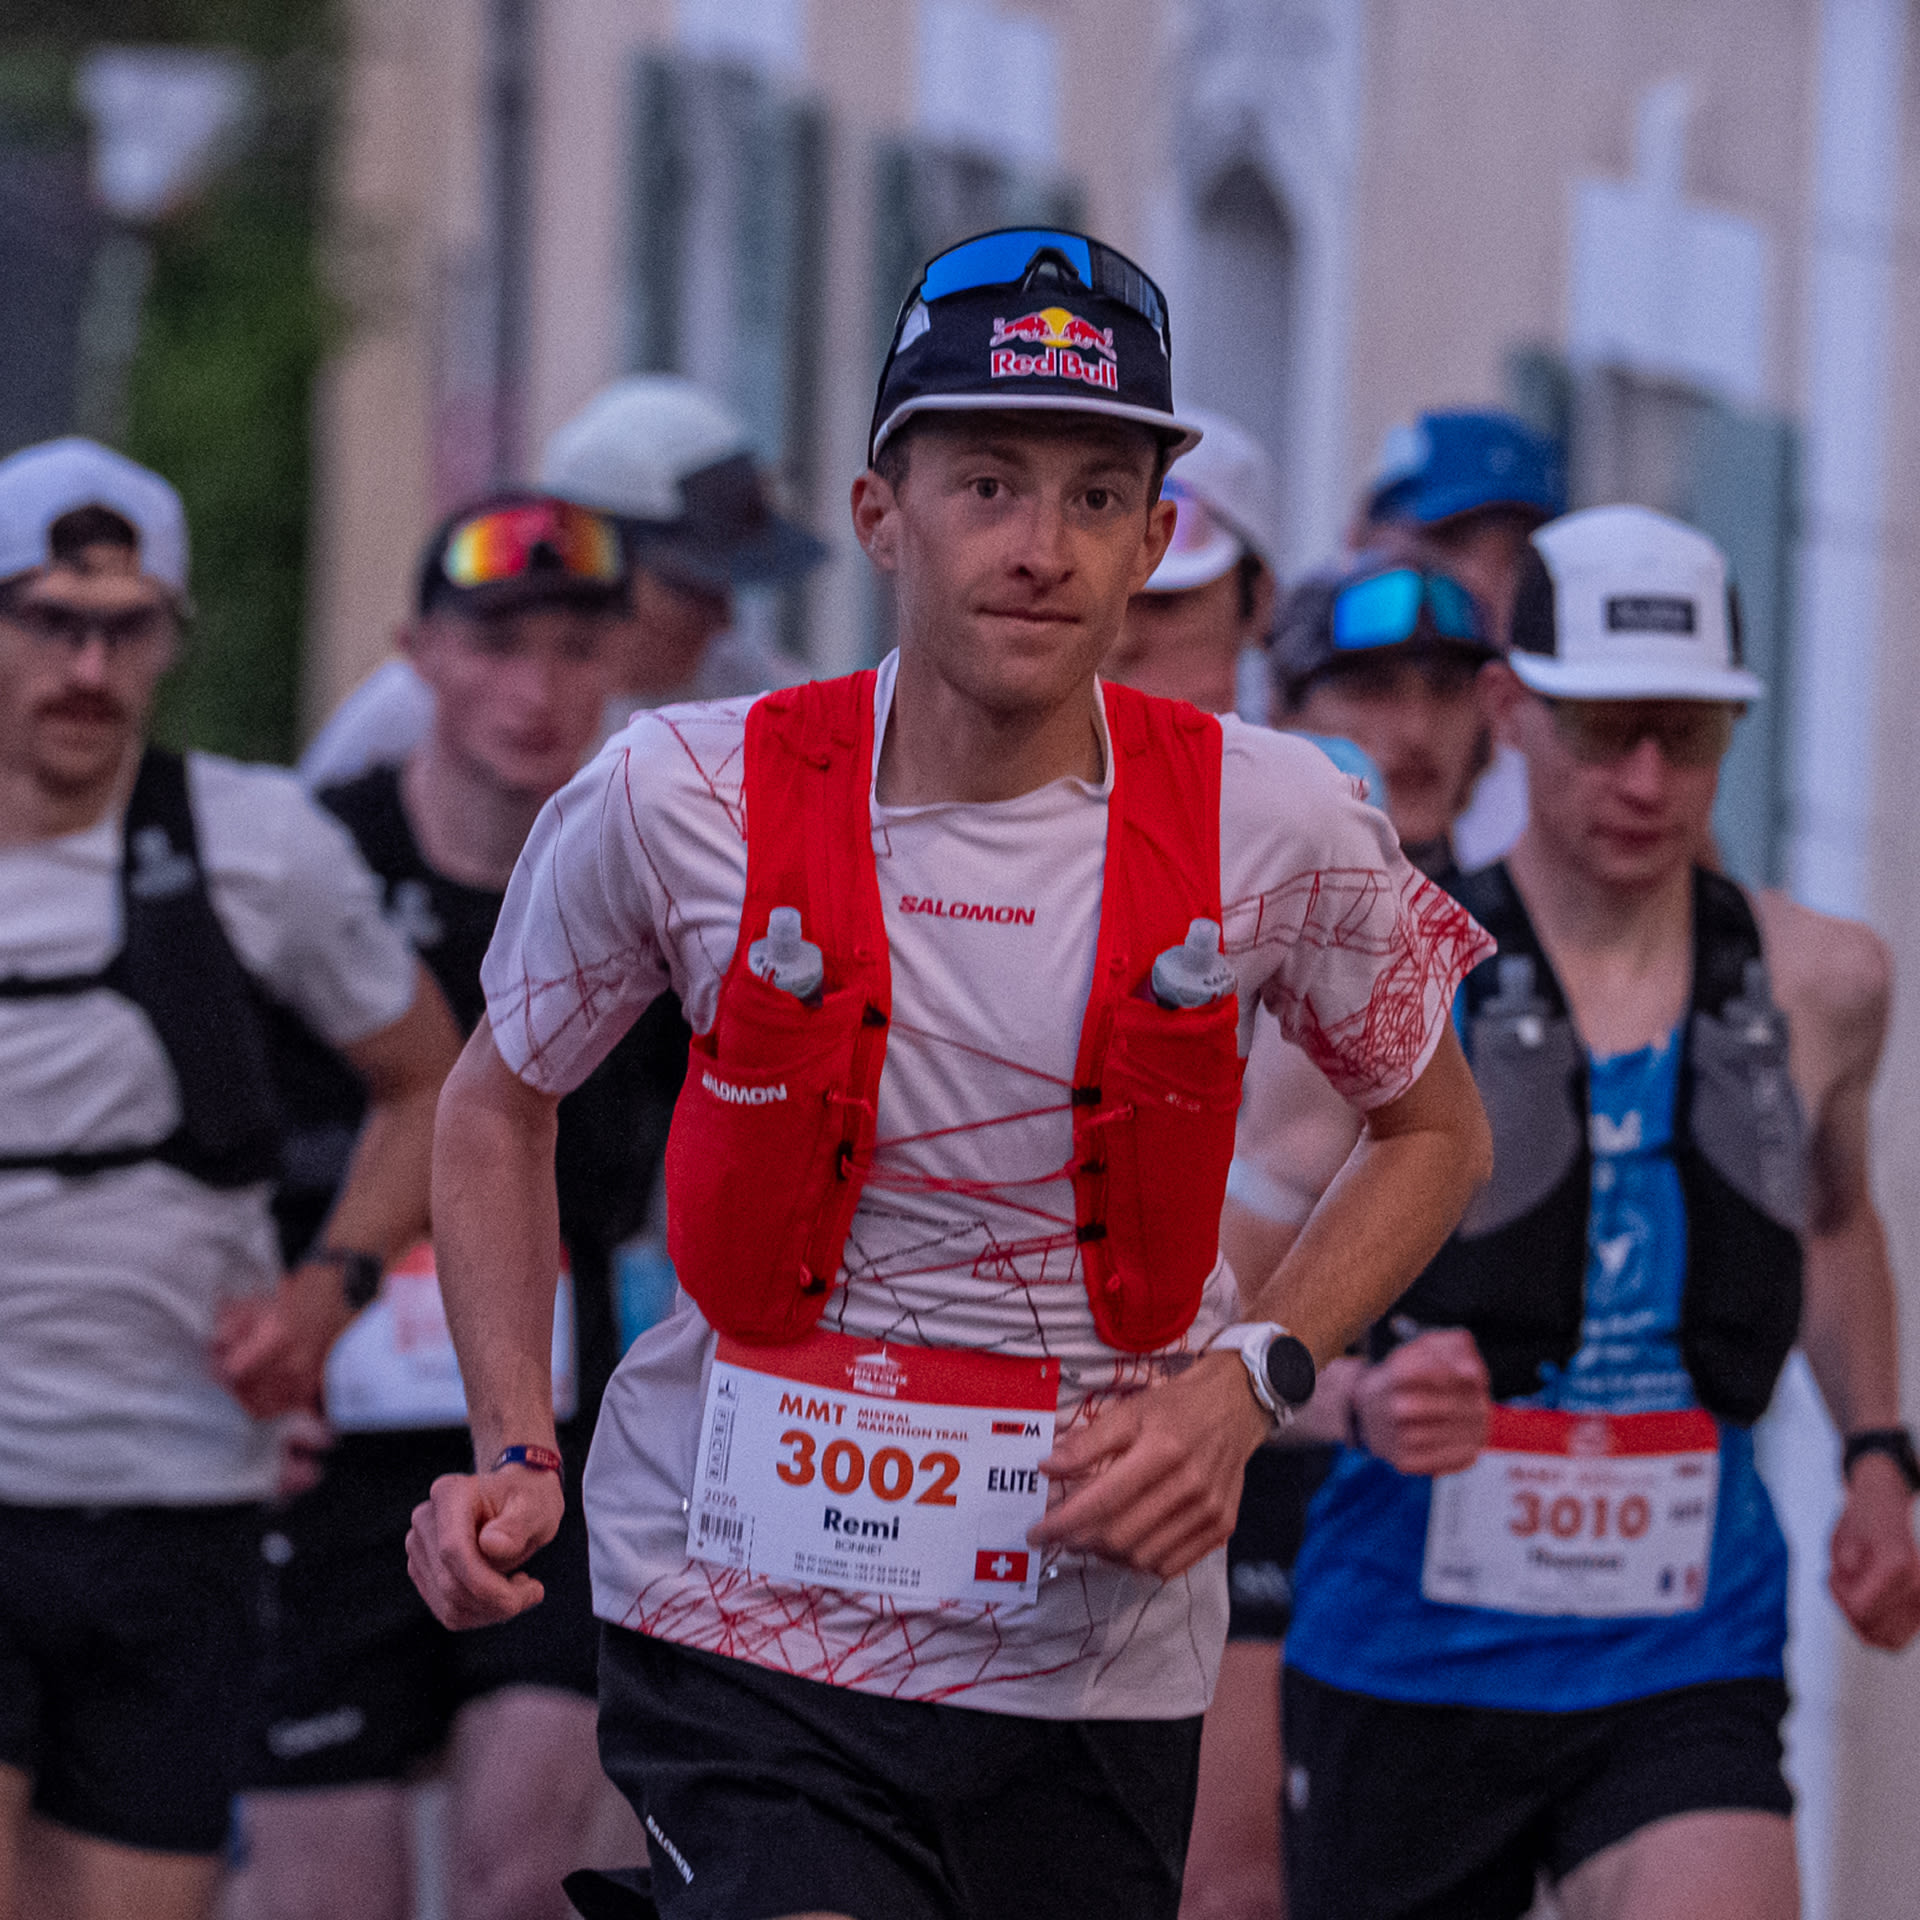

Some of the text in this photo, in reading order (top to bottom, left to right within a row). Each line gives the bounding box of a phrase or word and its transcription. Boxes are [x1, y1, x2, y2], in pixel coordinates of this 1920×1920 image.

[991, 347, 1118, 391] Red Bull
[899, 895, 1035, 926] SALOMON
[778, 1392, 847, 1426] MMT
[858, 1408, 910, 1424] MISTRAL
[857, 1420, 968, 1442] MARATHON TRAIL
[776, 1429, 961, 1507] 3002
[987, 1466, 1039, 1493] ELITE
[704, 1488, 738, 1508] 2026
[823, 1507, 900, 1541] Remi
[1510, 1491, 1651, 1540] 3010
[646, 1814, 695, 1885] SALOMON
